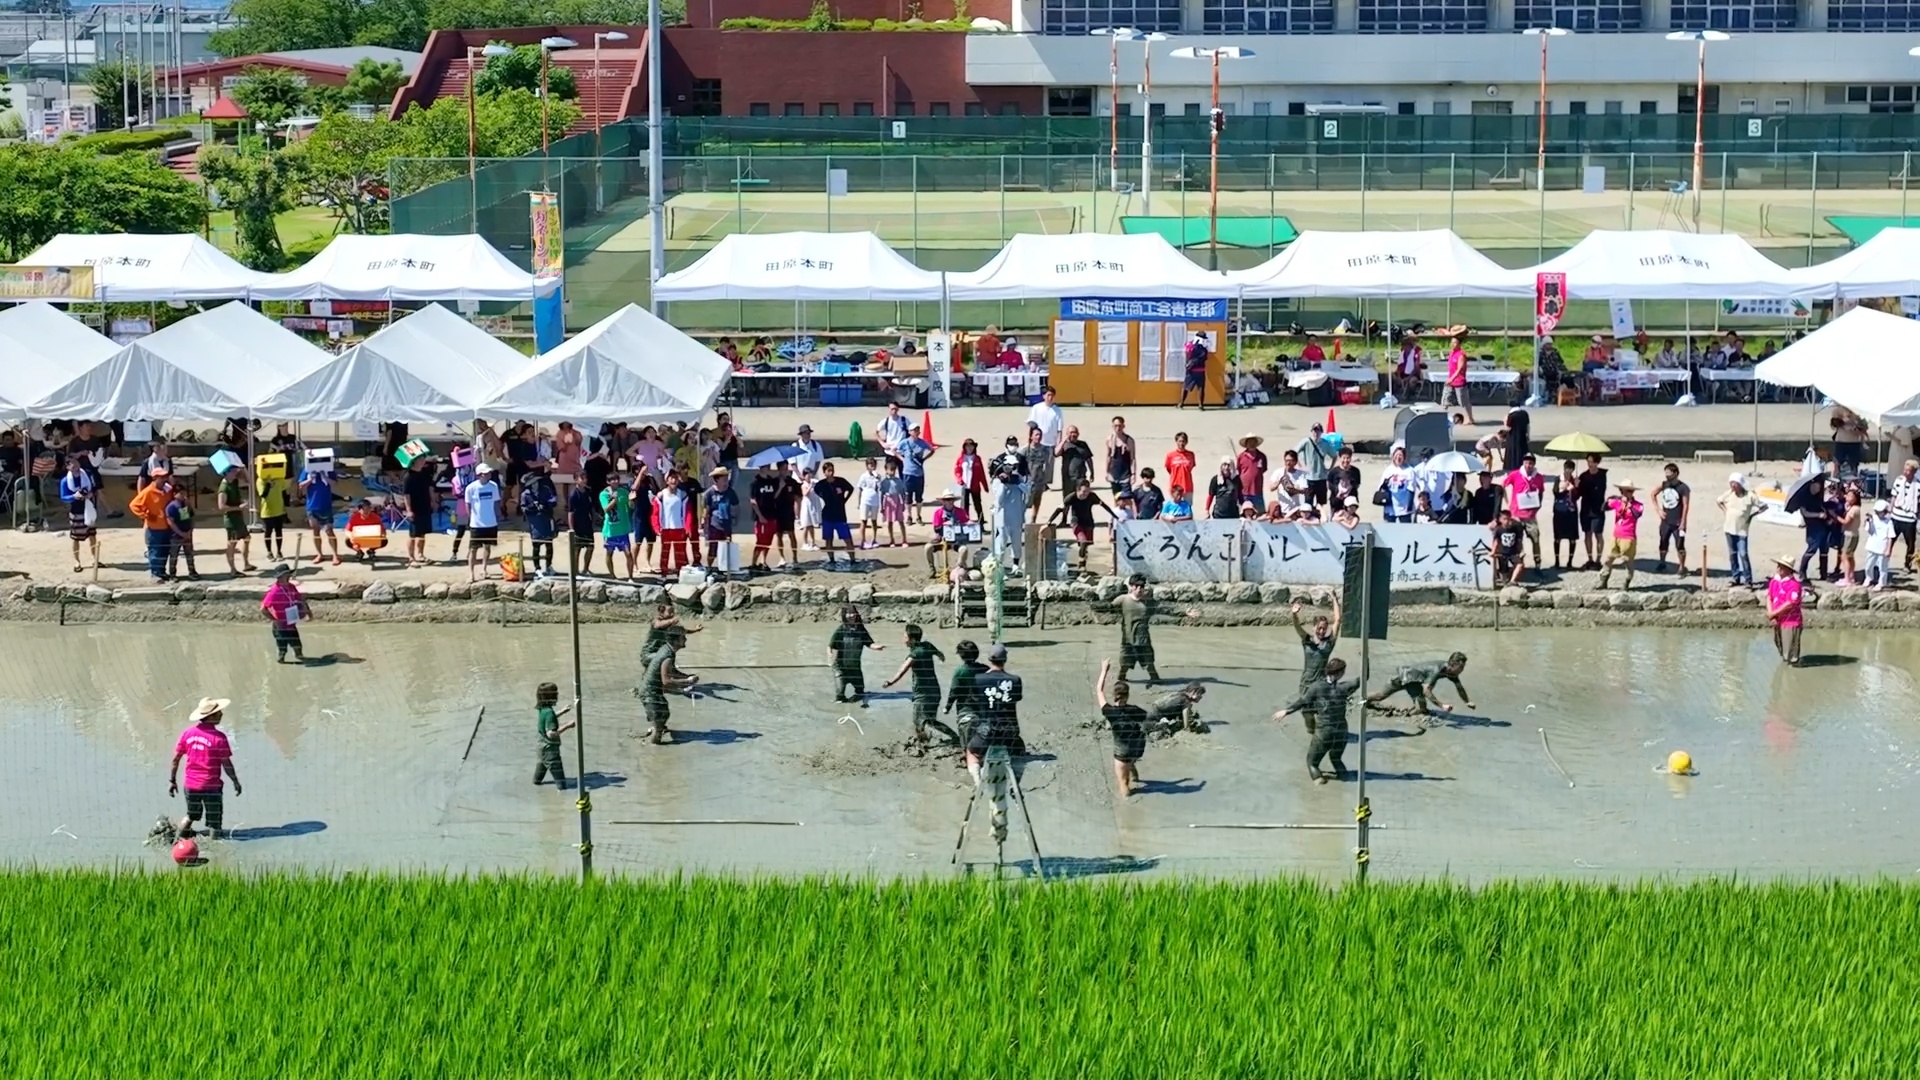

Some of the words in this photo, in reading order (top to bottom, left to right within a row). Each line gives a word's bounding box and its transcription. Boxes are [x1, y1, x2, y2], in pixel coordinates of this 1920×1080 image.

[1326, 122, 1336, 135] 2
[1750, 121, 1760, 135] 3
[367, 258, 436, 271] 田原本町
[765, 258, 834, 271] 田原本町
[1055, 259, 1124, 273] 田原本町
[1348, 254, 1417, 267] 田原本町
[1639, 253, 1710, 270] 田原本町
[1071, 300, 1216, 318] 田原本町商工会青年部
